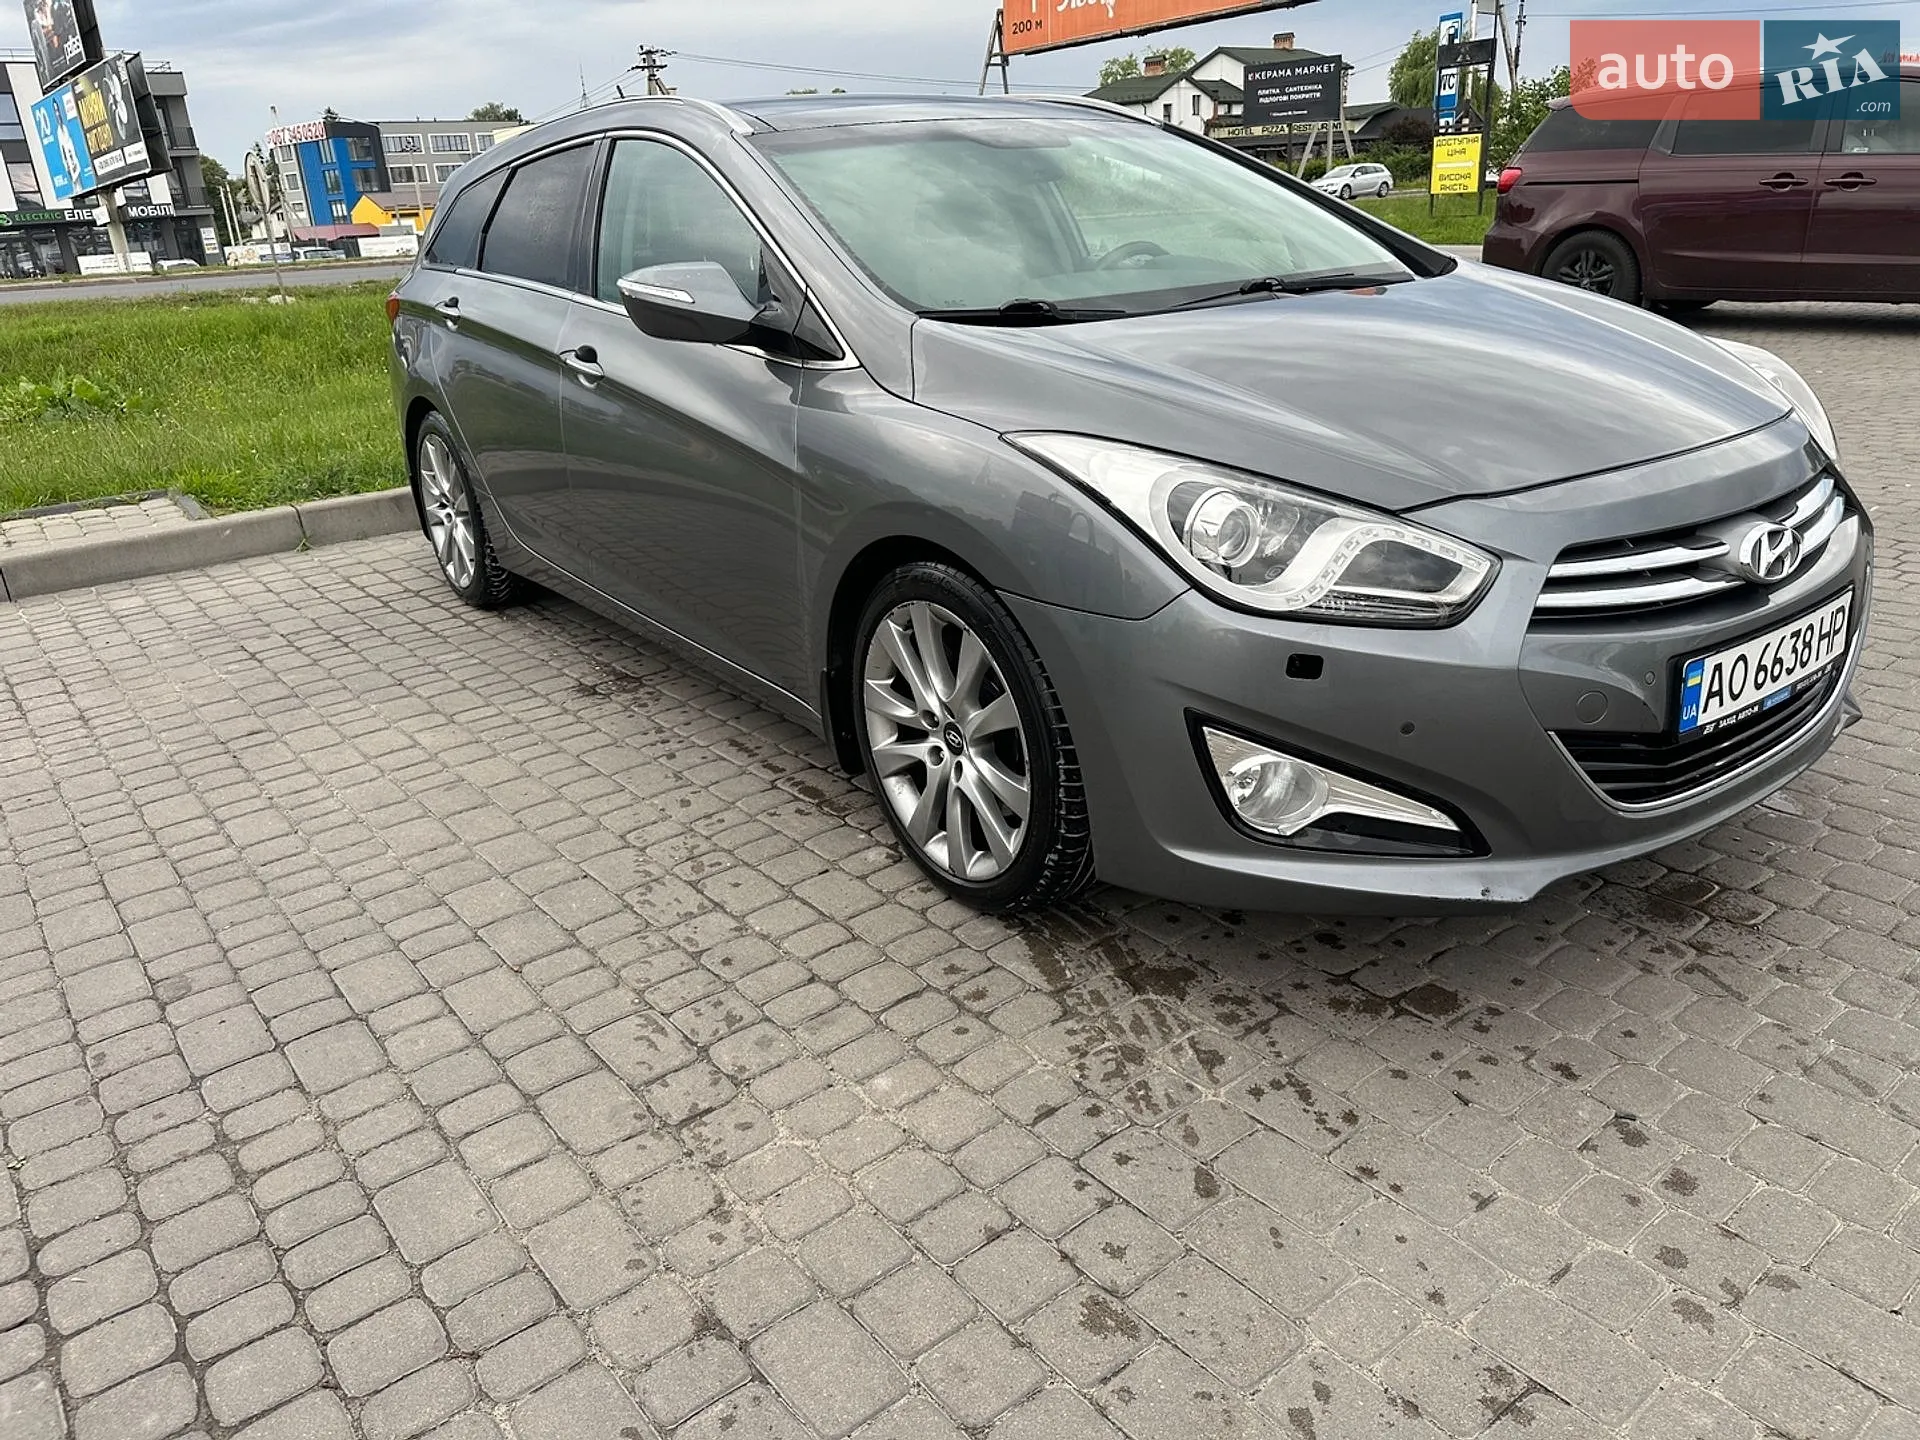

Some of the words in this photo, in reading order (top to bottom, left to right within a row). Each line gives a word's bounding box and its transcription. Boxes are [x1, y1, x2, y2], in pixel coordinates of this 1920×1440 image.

[1011, 20, 1032, 35] 200
[1255, 68, 1292, 81] КЕРАМА
[1294, 63, 1336, 76] МАРКЕТ
[1227, 128, 1254, 136] HOTEL
[1261, 125, 1285, 134] PIZZA
[1293, 122, 1342, 132] RESTURNT
[1436, 136, 1480, 147] ДОСТУПНА
[1446, 148, 1467, 157] ЦІНА
[1438, 173, 1472, 182] ВИСОКА
[1439, 184, 1469, 192] ЯКІСТЬ
[14, 212, 62, 221] ELECTRIC
[1753, 622, 1815, 692] 6638
[1682, 705, 1698, 721] UA
